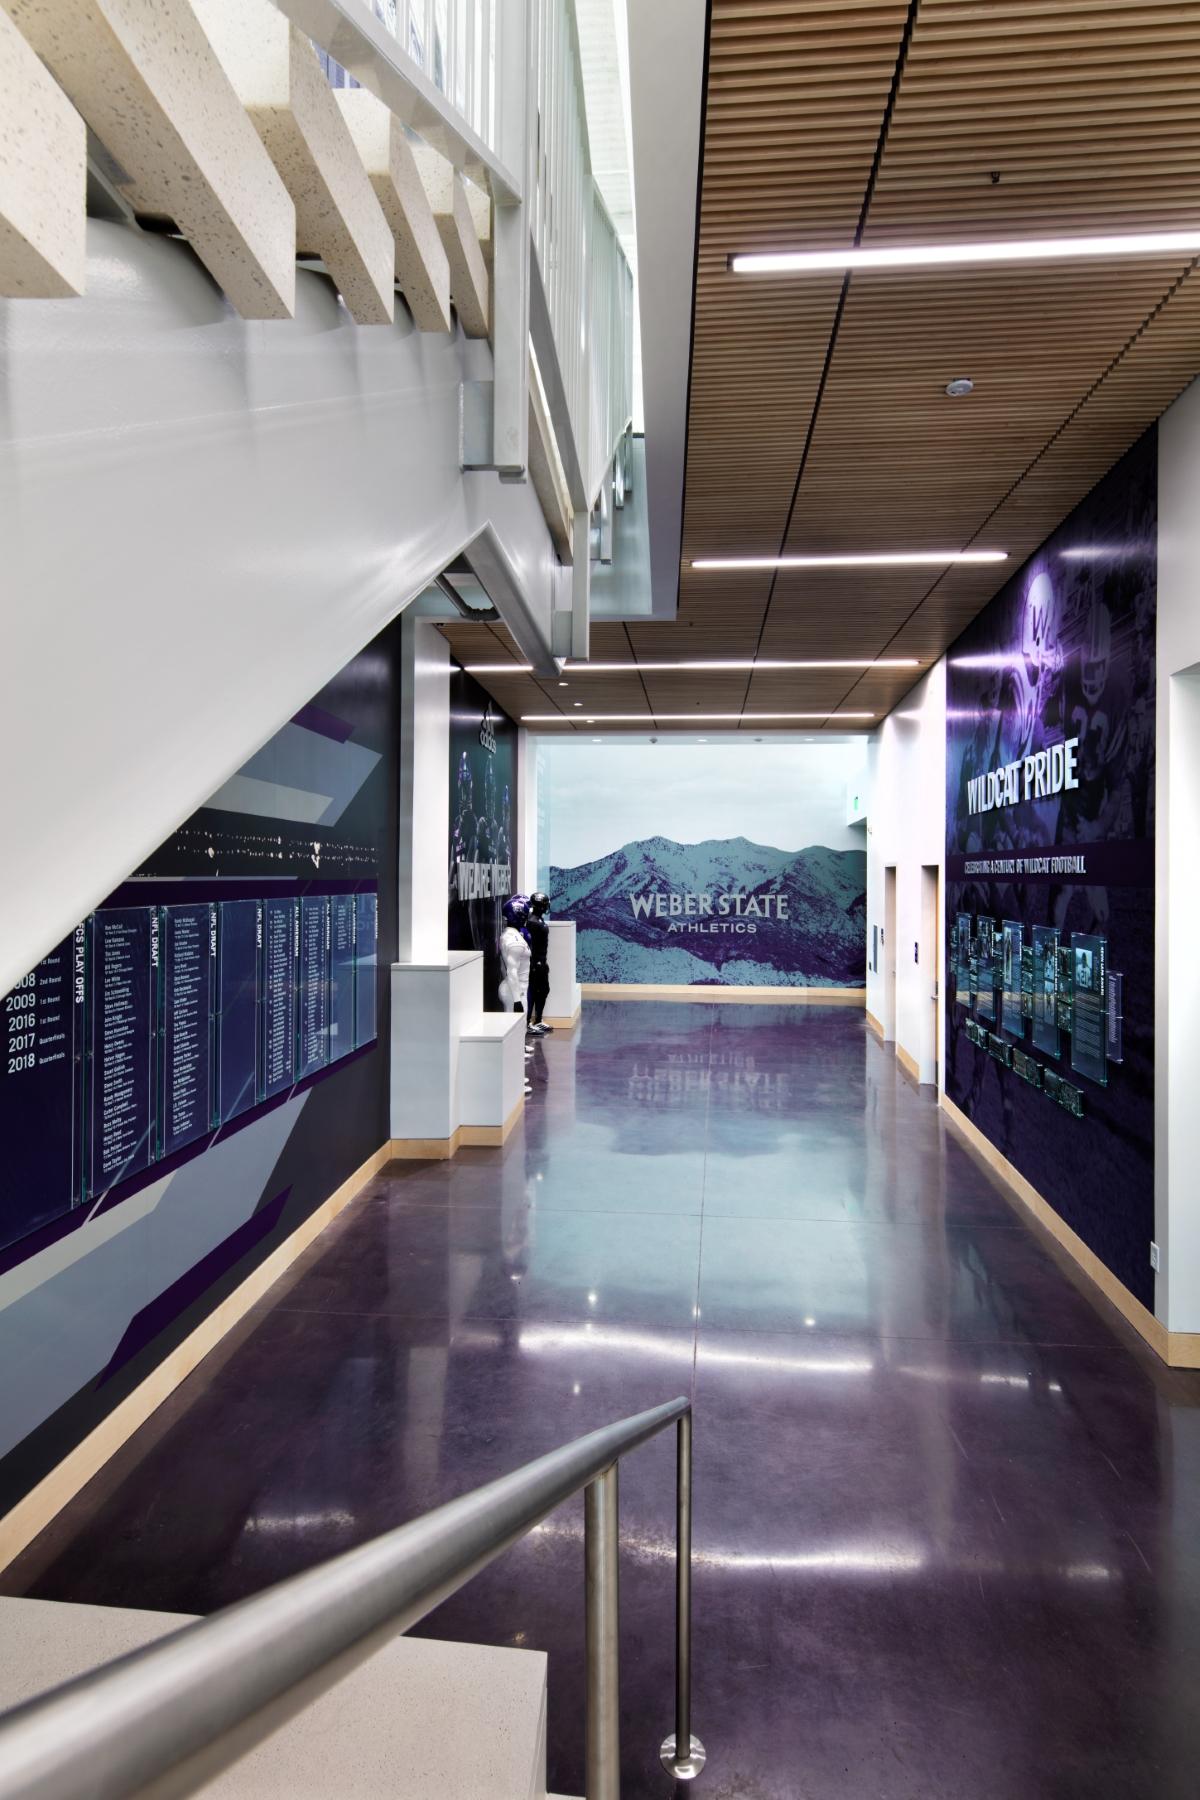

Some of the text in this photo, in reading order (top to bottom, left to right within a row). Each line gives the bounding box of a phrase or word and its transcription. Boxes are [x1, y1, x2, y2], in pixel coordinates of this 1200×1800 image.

[967, 737, 1079, 816] WILDCAT PRIDE
[1016, 858, 1024, 873] OF
[1024, 857, 1049, 873] WILDCAT
[1051, 855, 1087, 873] FOOTBALL.
[629, 893, 789, 920] WEBER STATE
[667, 923, 757, 934] ATHLETICS
[151, 917, 159, 967] NFL DRAFT
[75, 946, 84, 973] PLAY
[75, 976, 84, 1004] OFFS
[6, 993, 36, 1012] 2009
[47, 995, 60, 1003] Round
[8, 1013, 36, 1032] 2016
[8, 1033, 65, 1053] 2017 Quarterfinals
[8, 1052, 65, 1074] 2018 Quarterfinals
